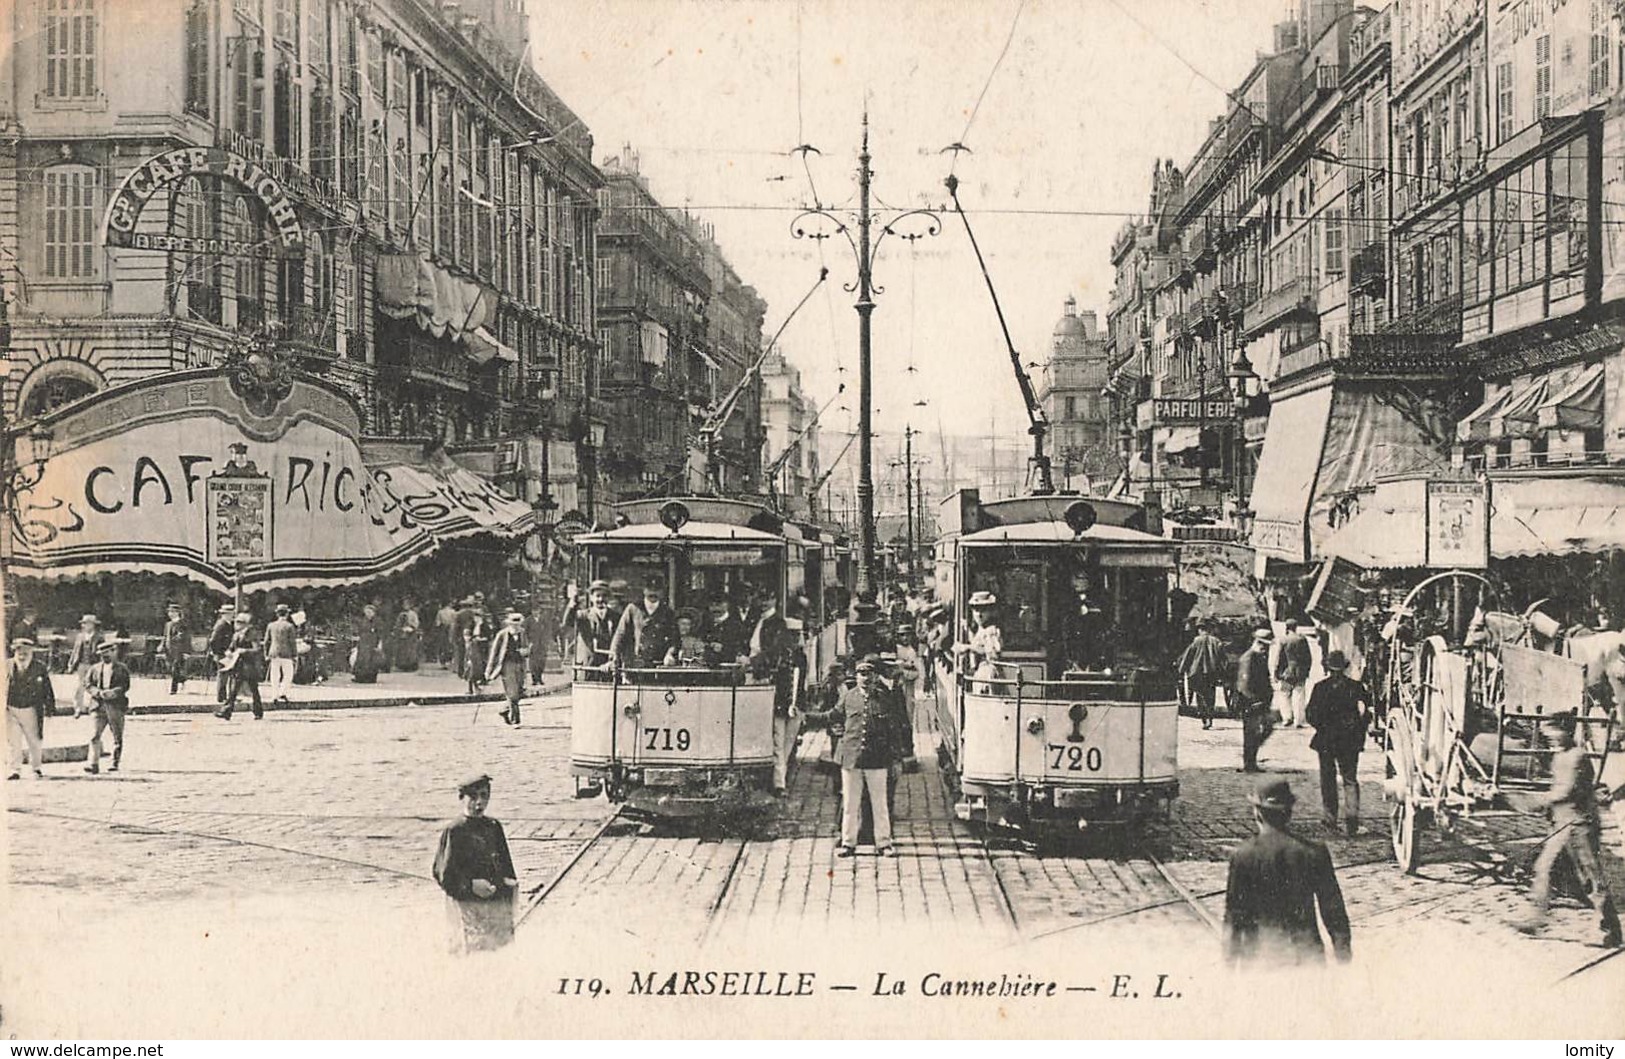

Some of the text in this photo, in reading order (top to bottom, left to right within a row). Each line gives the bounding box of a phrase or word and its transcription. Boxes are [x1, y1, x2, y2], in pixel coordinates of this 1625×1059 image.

[223, 152, 303, 247] RICHE
[644, 727, 691, 753] 719
[1048, 744, 1103, 772] 720
